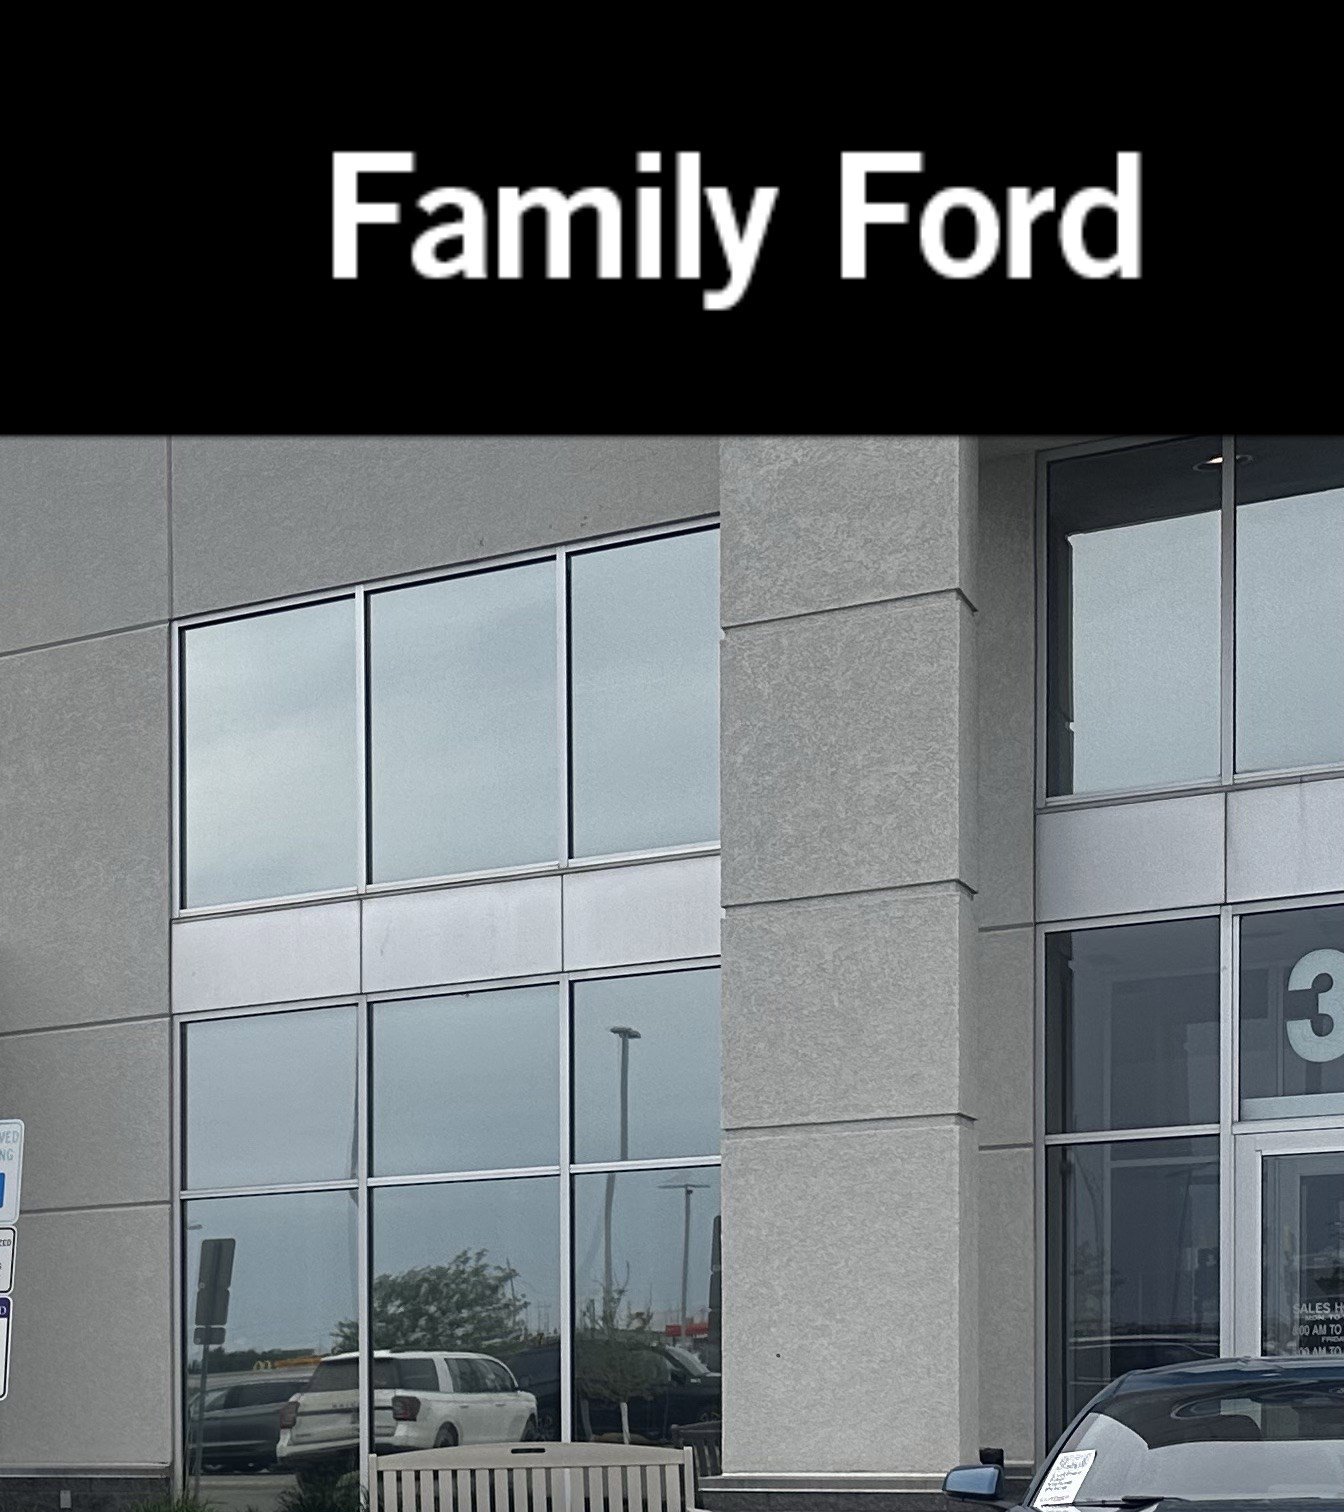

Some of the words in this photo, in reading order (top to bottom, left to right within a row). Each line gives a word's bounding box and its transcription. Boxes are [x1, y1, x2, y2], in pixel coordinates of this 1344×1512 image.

[1292, 1302, 1331, 1314] SALES
[1312, 1324, 1327, 1335] AM
[1329, 1324, 1342, 1335] TO
